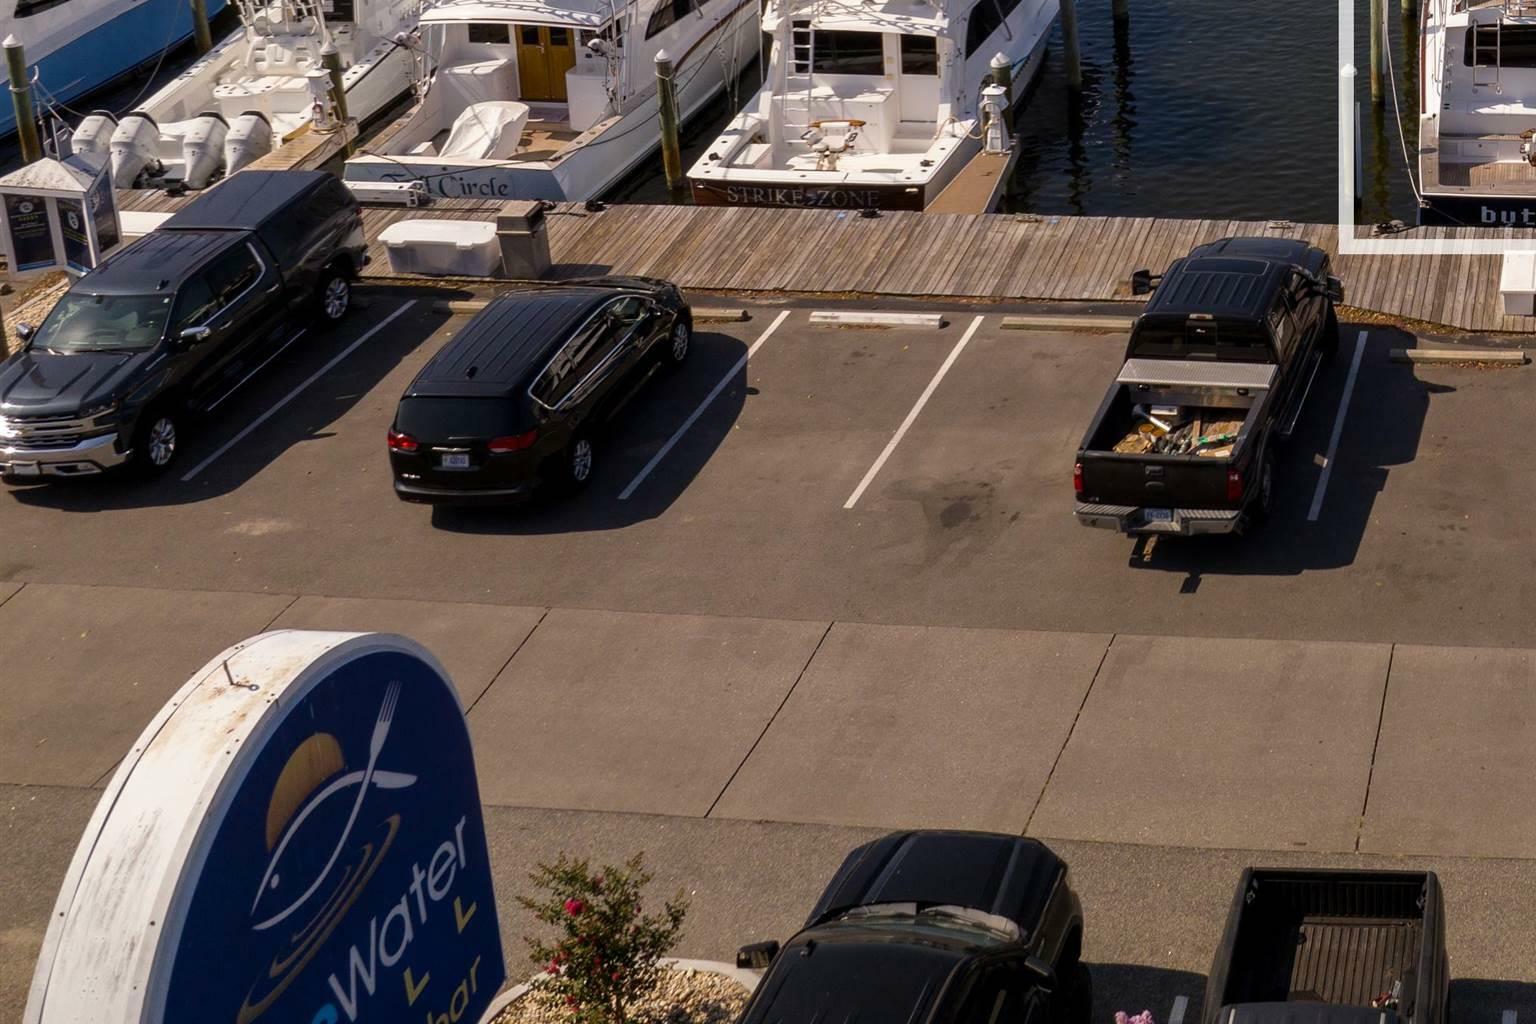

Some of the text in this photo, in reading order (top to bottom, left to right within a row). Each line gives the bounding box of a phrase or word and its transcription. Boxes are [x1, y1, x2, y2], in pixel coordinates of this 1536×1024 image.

[439, 175, 509, 199] Circle
[727, 185, 881, 207] STRIKE ZONE
[328, 814, 467, 1023] Water
